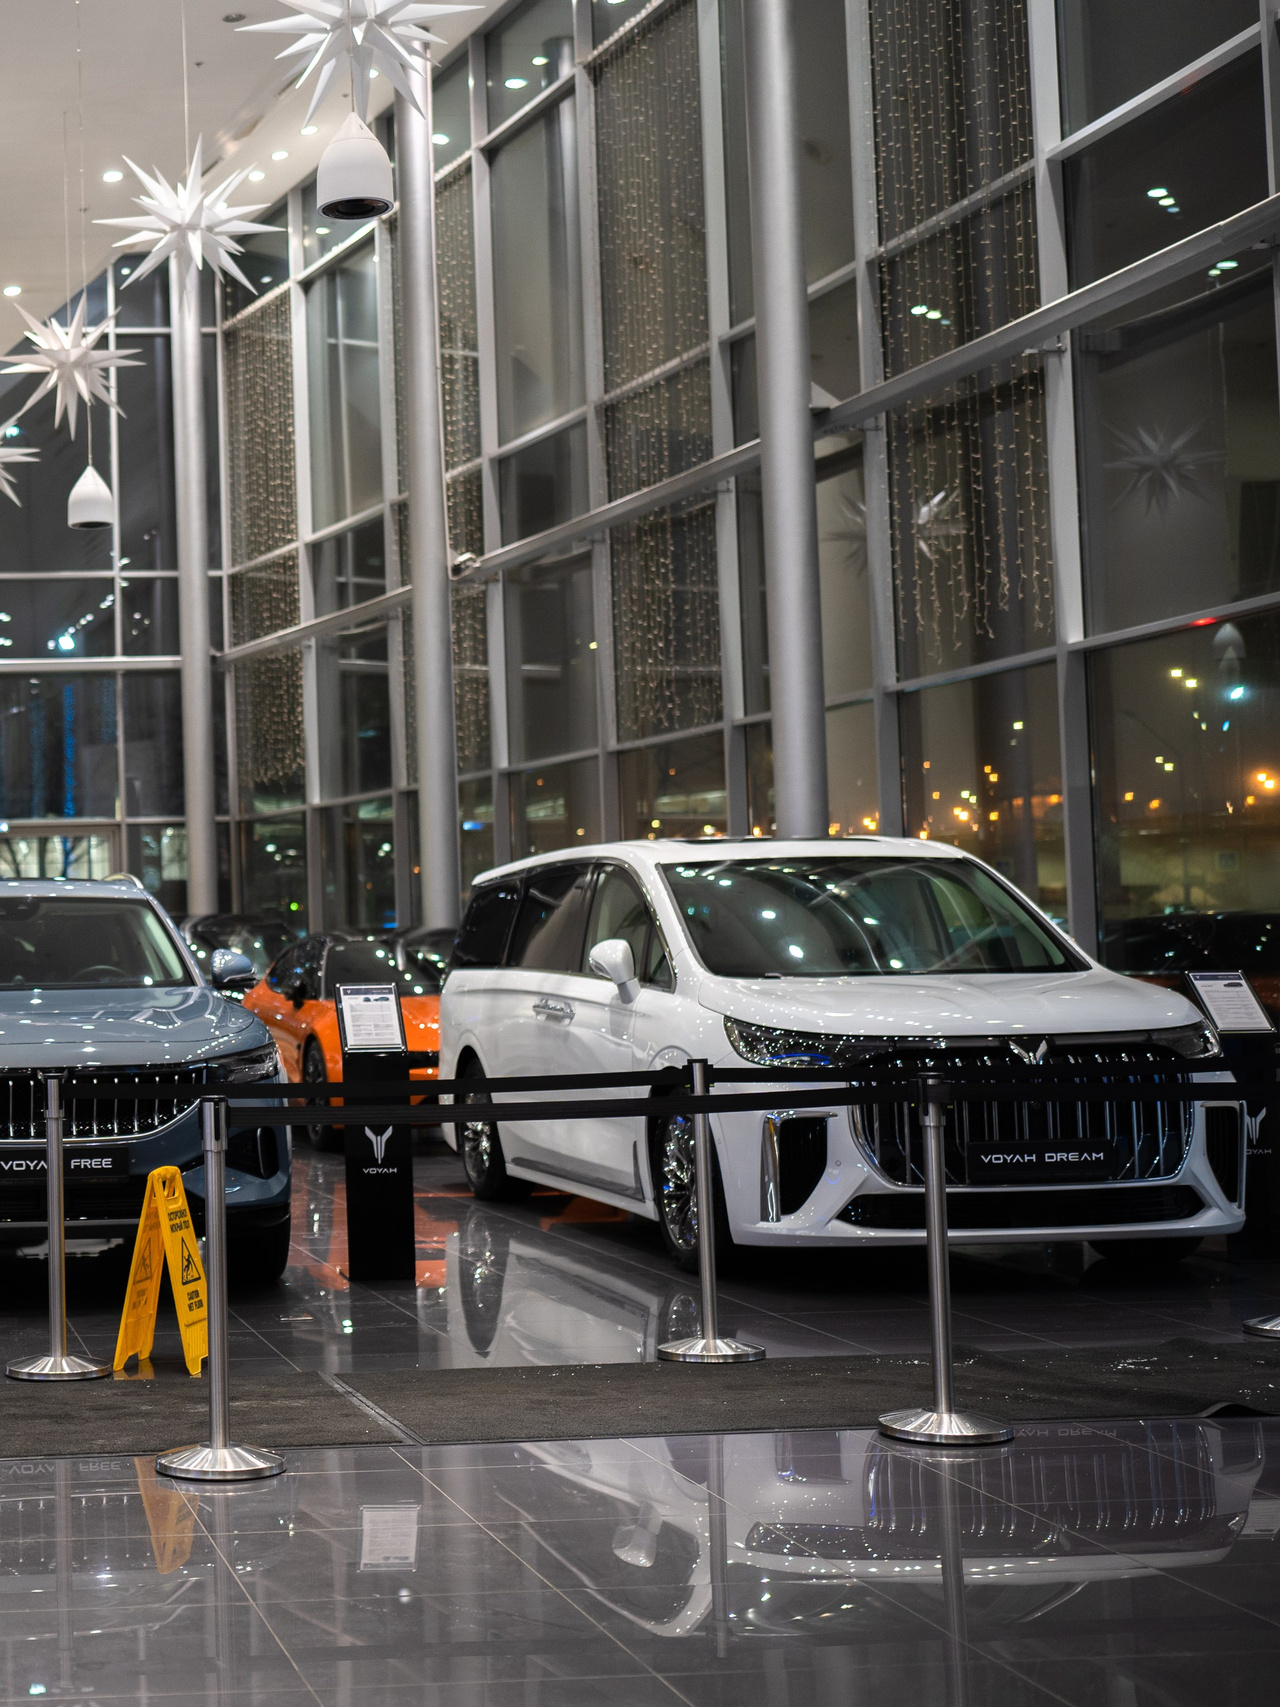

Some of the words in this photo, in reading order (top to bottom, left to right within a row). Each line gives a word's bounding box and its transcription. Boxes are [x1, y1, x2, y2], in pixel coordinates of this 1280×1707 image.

[980, 1153, 1037, 1164] VOYAH
[1044, 1152, 1104, 1163] DREAM
[0, 1160, 48, 1171] VOYA
[70, 1158, 113, 1169] FREE
